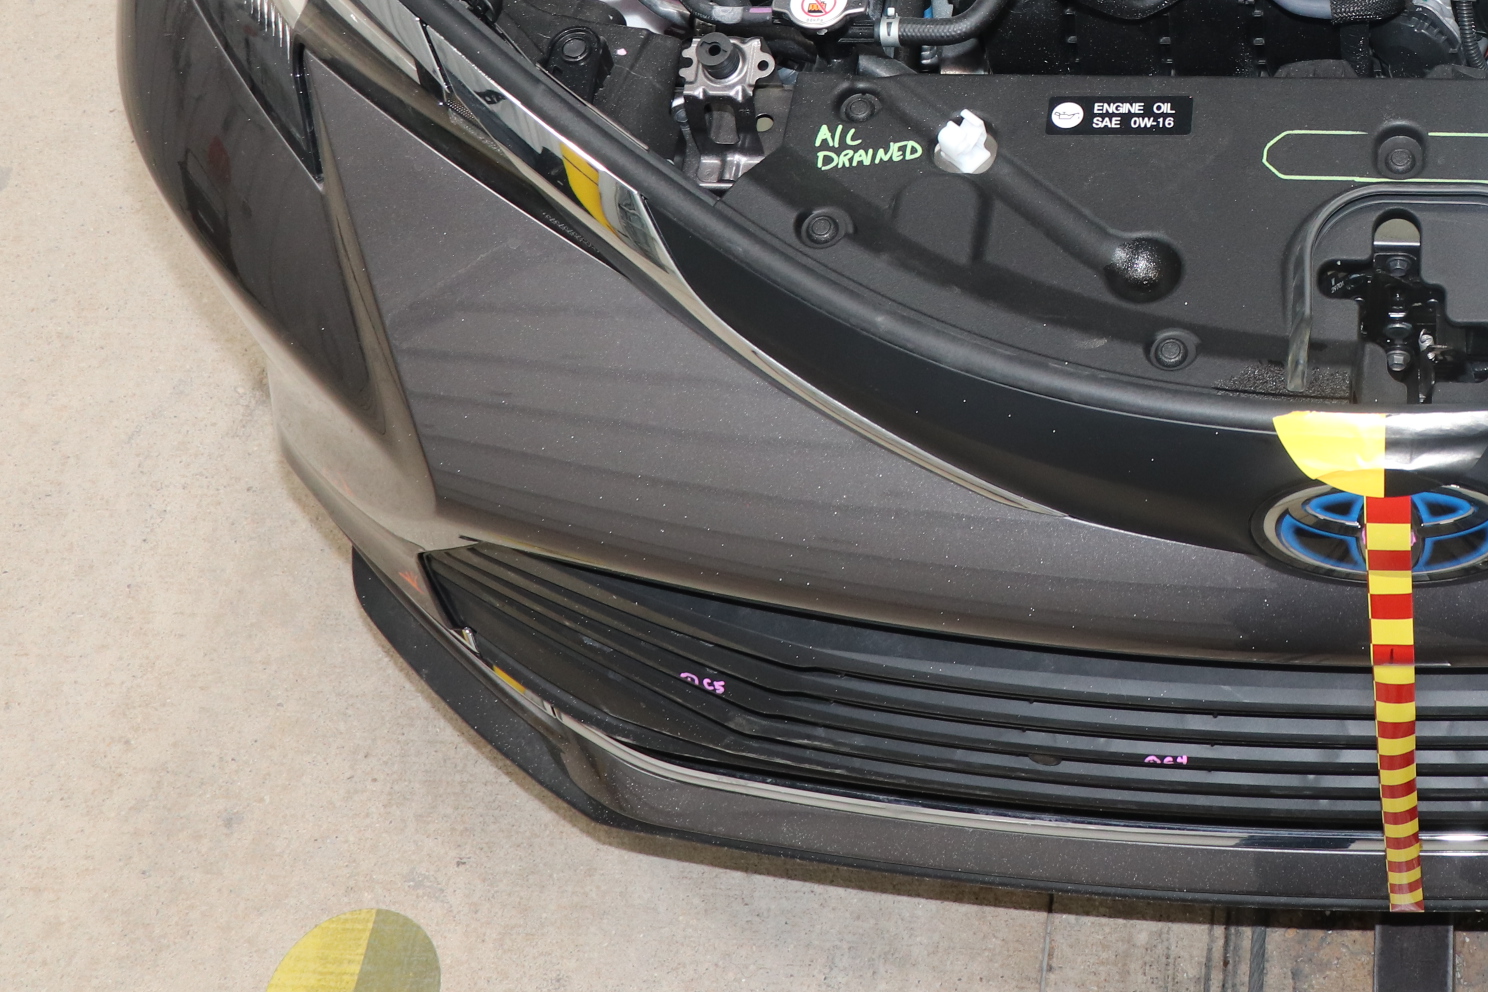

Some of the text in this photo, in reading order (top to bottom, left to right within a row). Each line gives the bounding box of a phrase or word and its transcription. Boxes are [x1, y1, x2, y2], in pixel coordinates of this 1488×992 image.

[1093, 102, 1176, 114] ENGINE OIL
[1092, 116, 1175, 129] SAE 0W-16
[814, 124, 863, 149] A/C
[816, 139, 923, 171] DRAINED
[702, 678, 726, 695] C5
